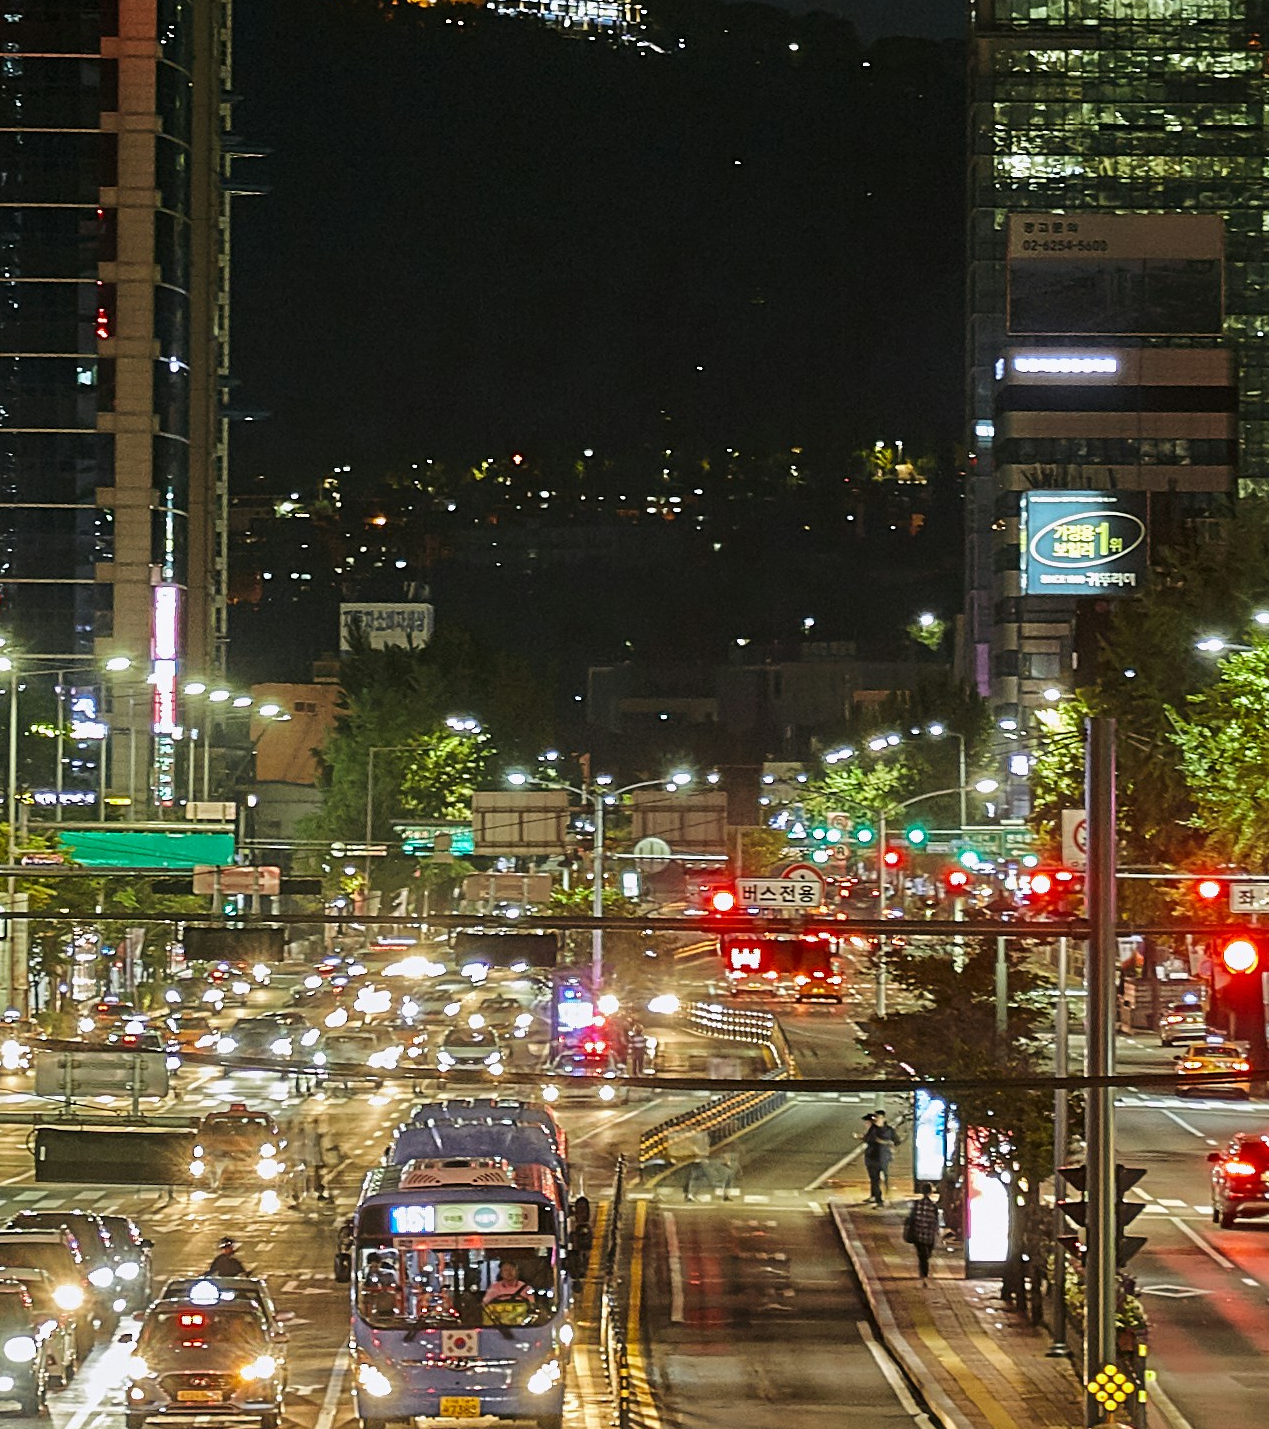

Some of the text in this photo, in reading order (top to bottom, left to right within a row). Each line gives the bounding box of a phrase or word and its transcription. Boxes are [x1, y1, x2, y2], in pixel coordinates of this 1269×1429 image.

[1053, 524, 1096, 542] 가정용
[1052, 542, 1095, 558] 보일러
[742, 884, 815, 903] 버스전용
